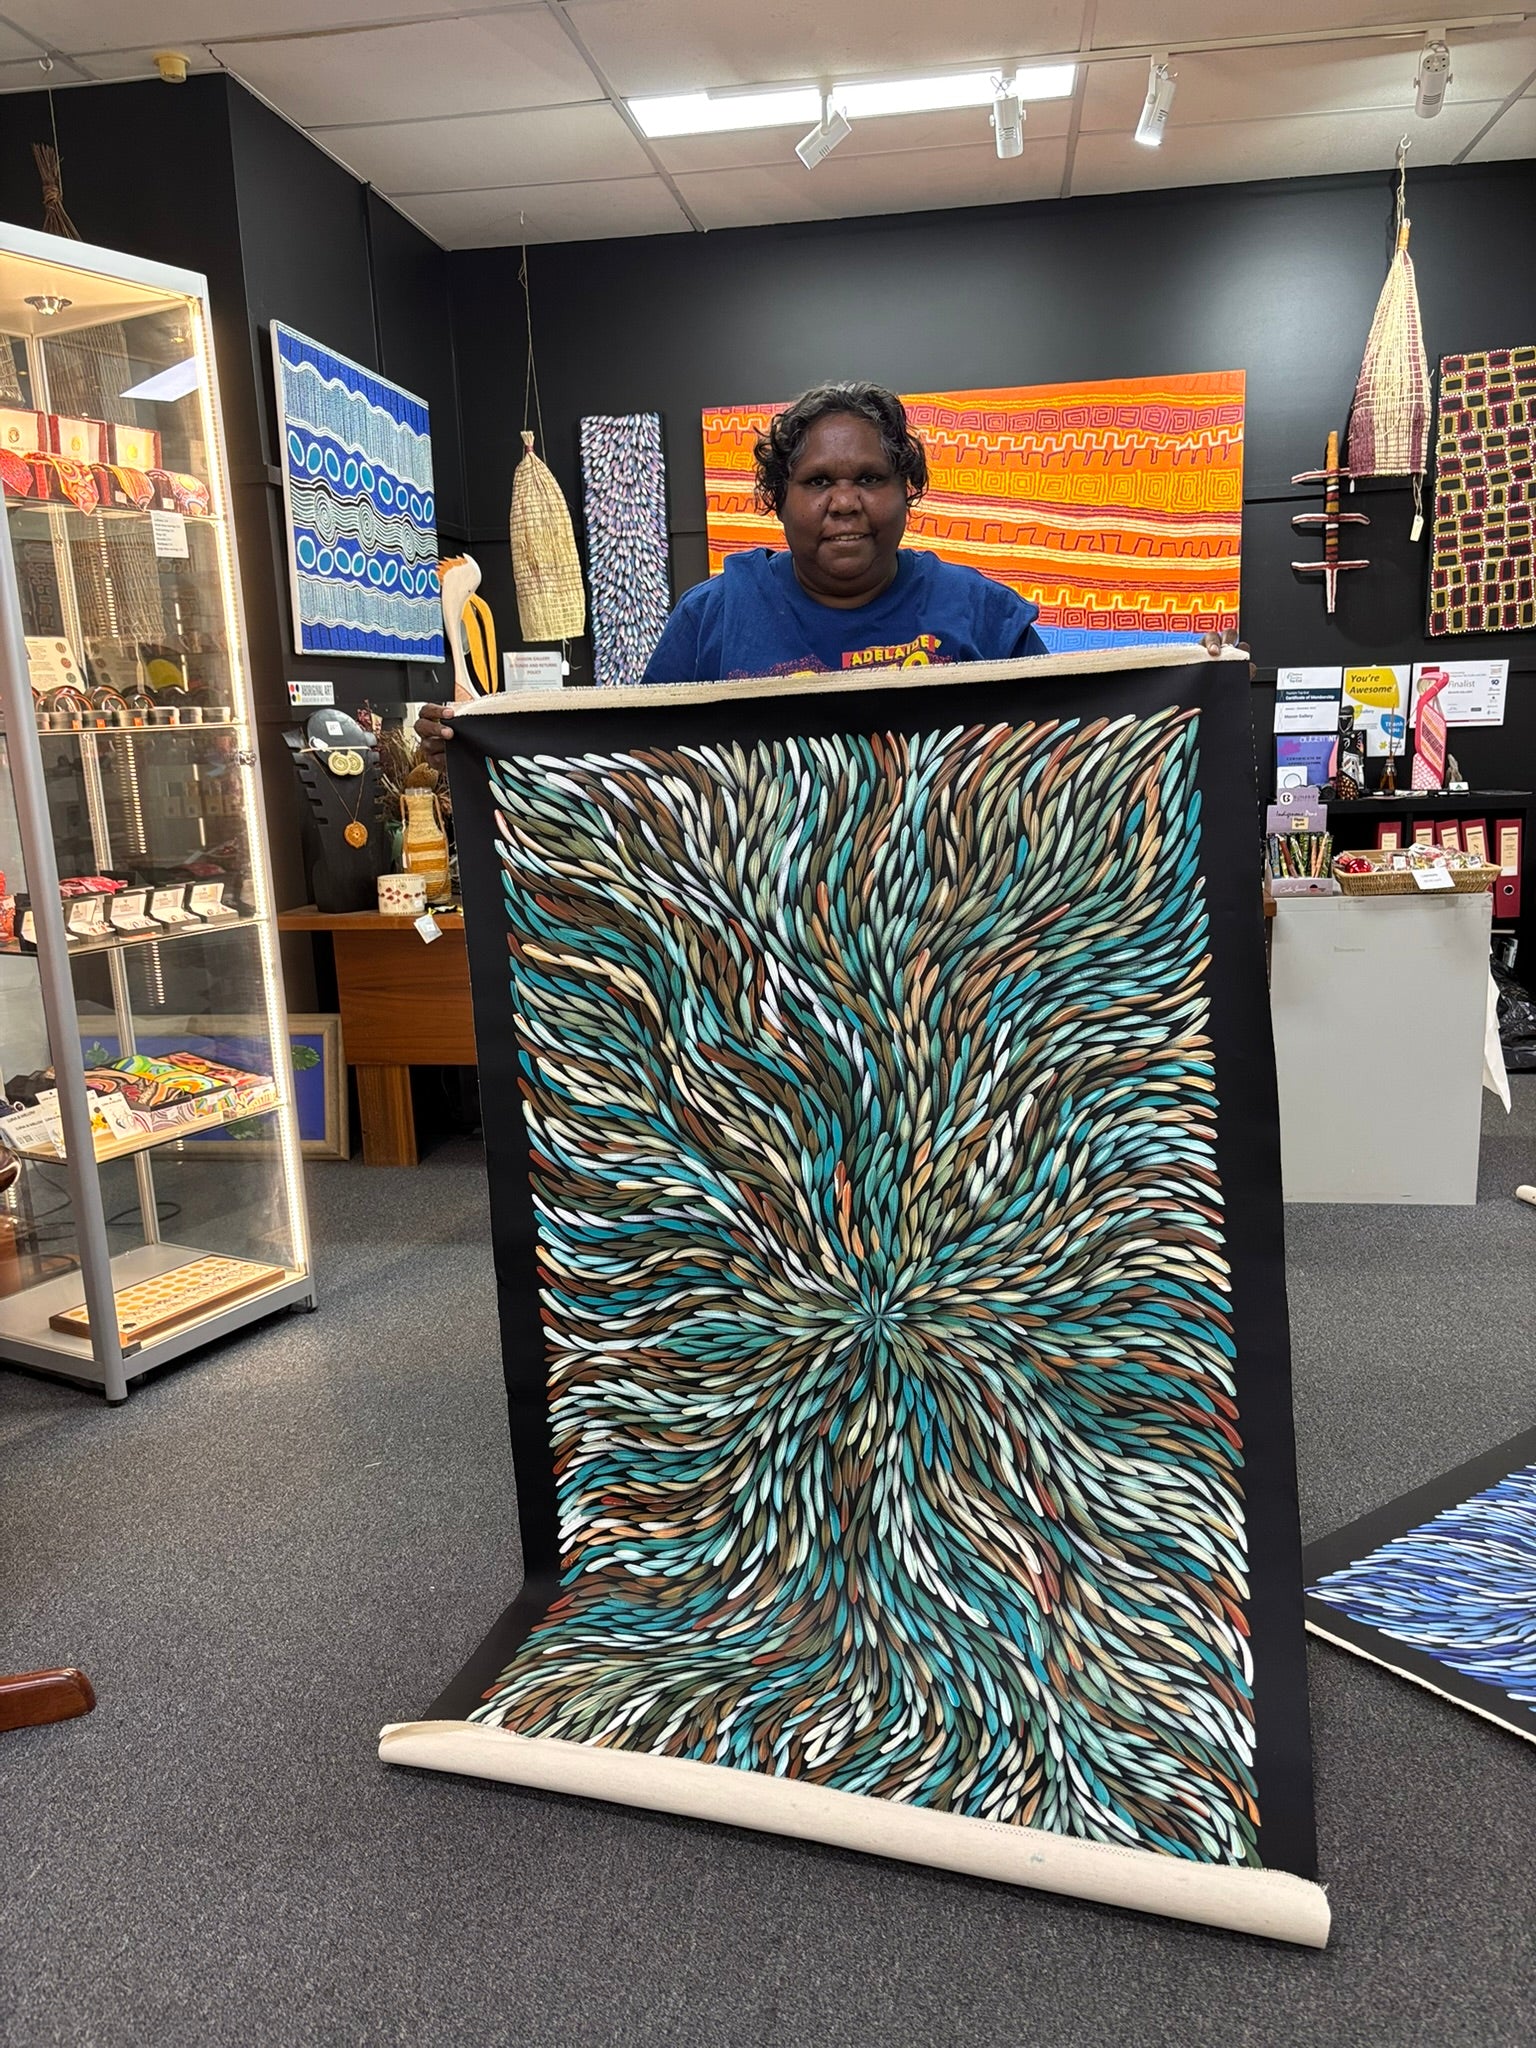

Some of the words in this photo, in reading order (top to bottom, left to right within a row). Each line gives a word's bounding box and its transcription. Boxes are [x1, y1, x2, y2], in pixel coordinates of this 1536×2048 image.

[852, 635, 929, 665] ADELAIDE
[1351, 674, 1380, 683] You're
[1448, 680, 1475, 688] Finalist
